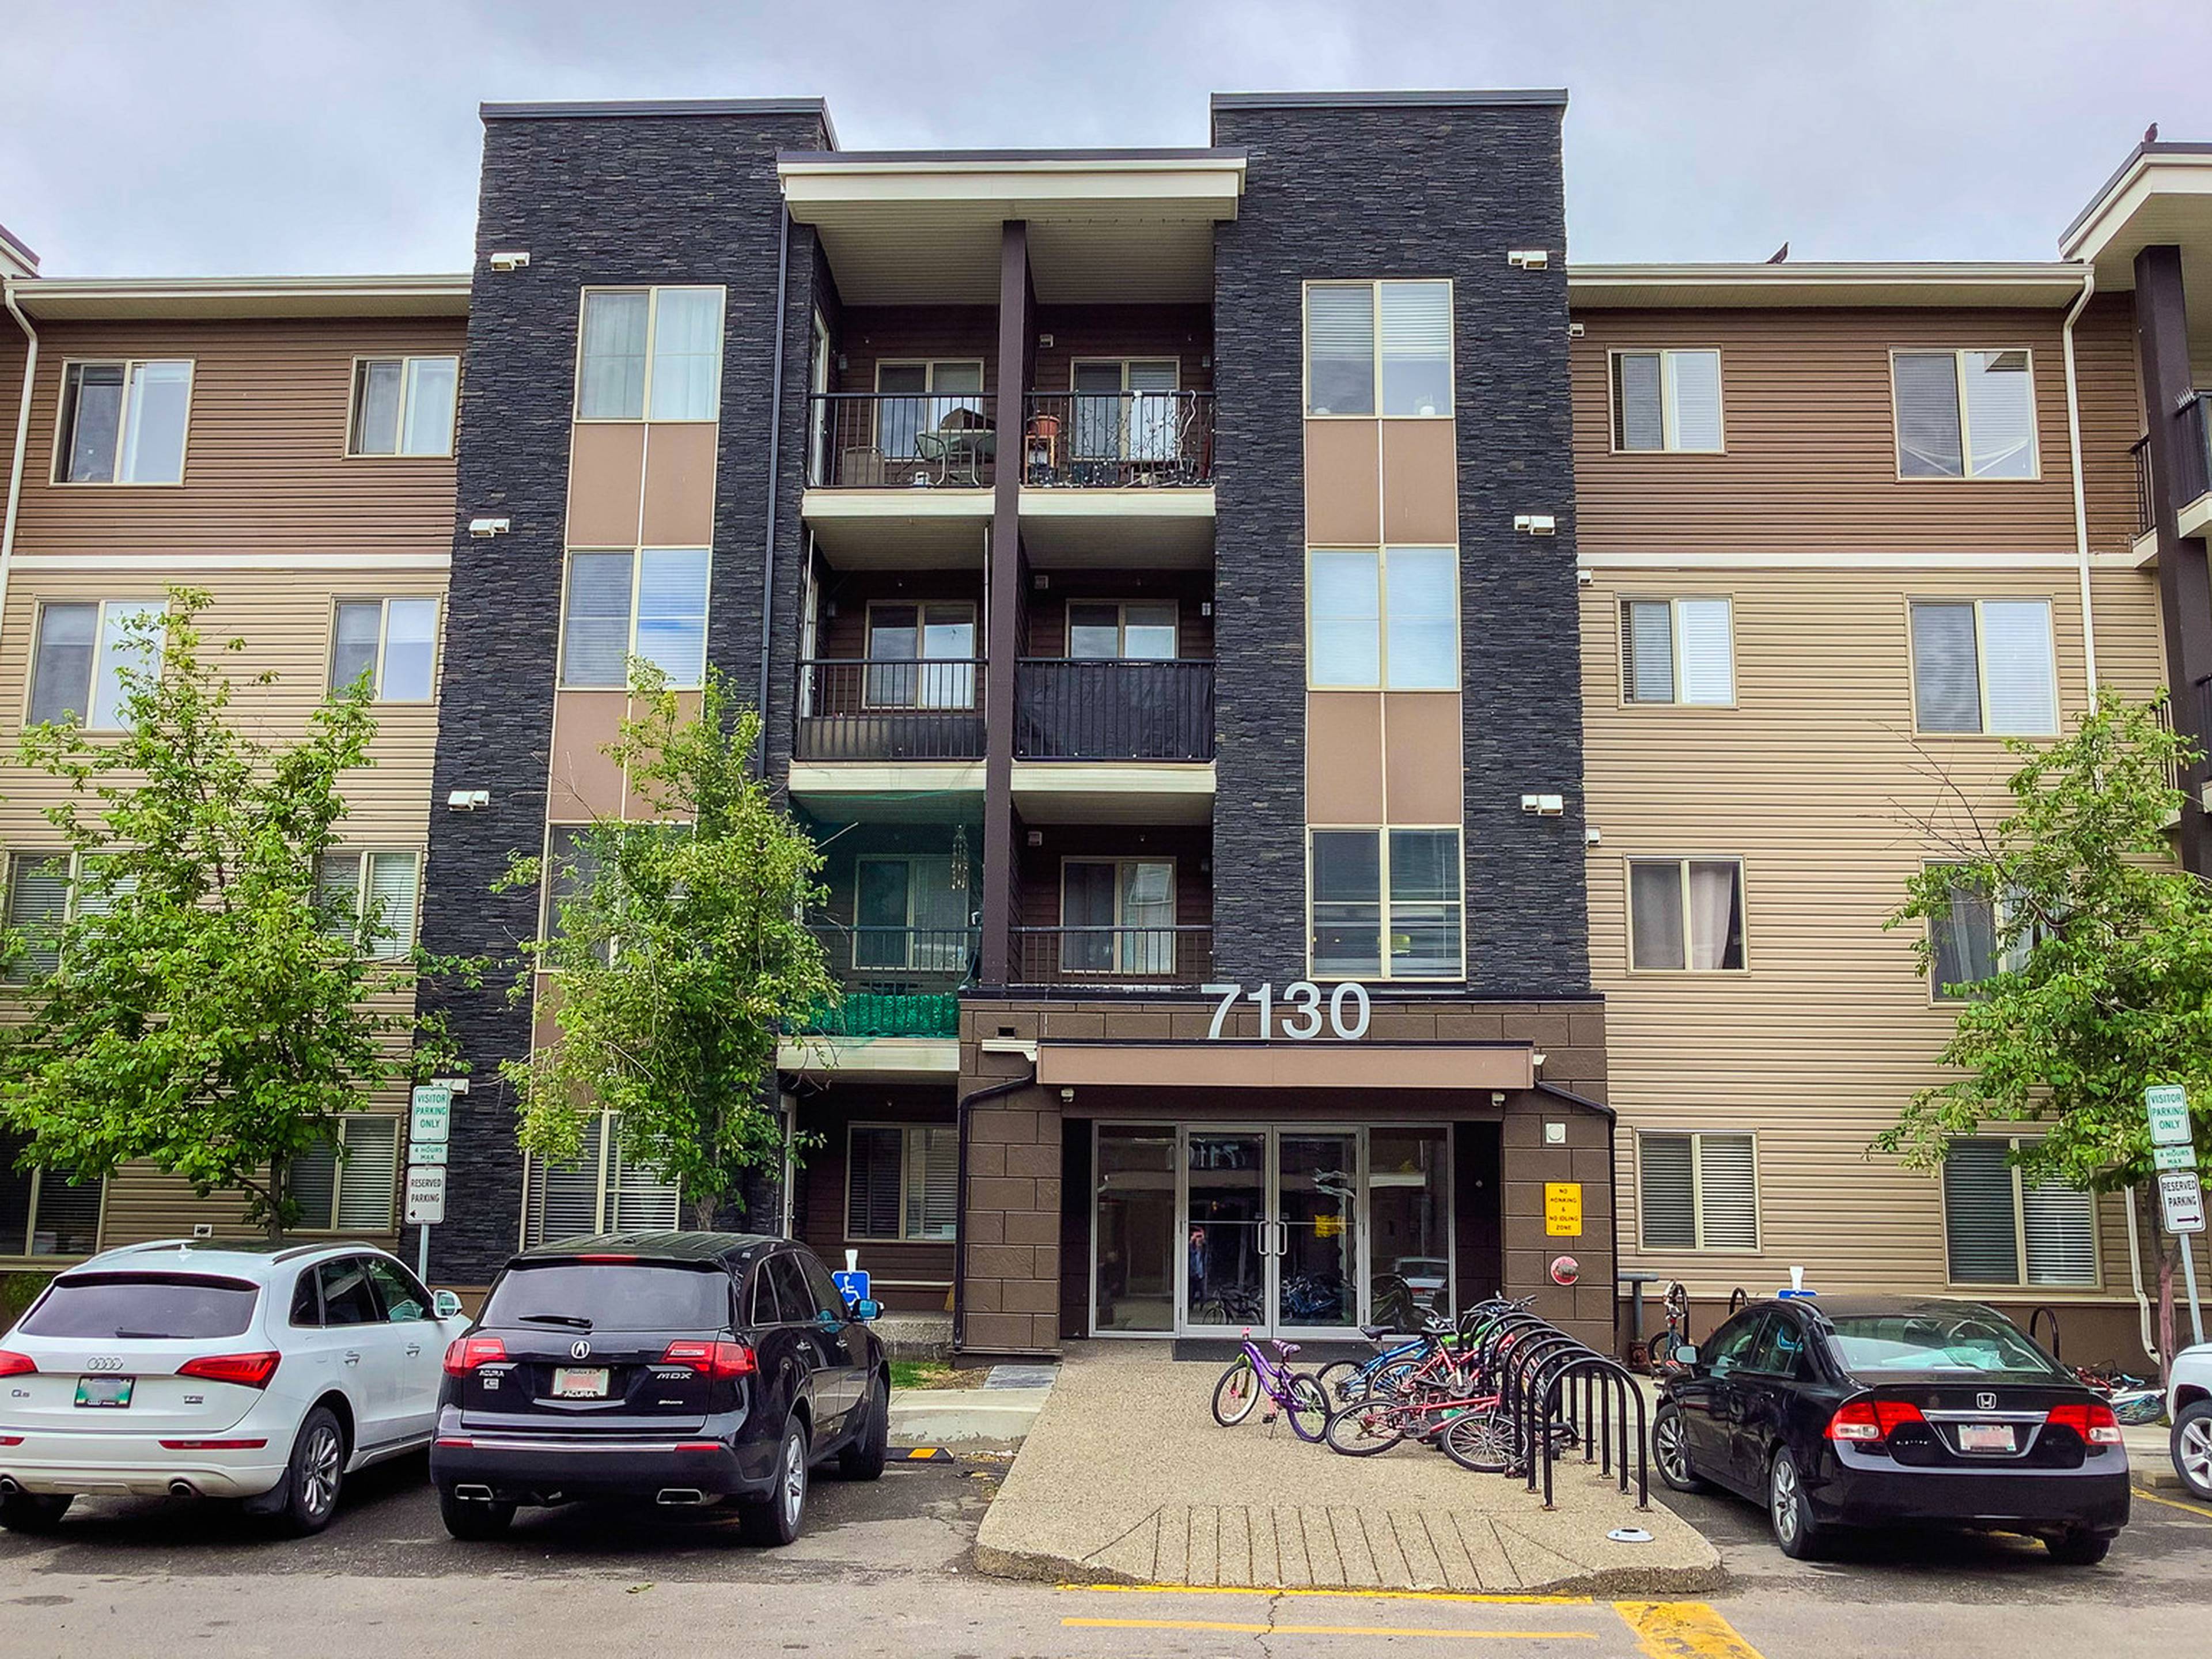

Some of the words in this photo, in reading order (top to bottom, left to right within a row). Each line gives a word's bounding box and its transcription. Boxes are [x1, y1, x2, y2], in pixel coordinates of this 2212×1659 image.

[1200, 981, 1371, 1040] 7130
[416, 1094, 446, 1103] VISITOR
[2150, 1093, 2182, 1104] VISITOR
[415, 1107, 446, 1115] PARKING
[2152, 1106, 2184, 1116] PARKING
[420, 1119, 440, 1128] ONLY
[2159, 1119, 2181, 1130] ONLY
[2165, 1150, 2190, 1158] HOURS
[411, 1178, 441, 1188] RESERVED
[2162, 1180, 2196, 1192] RESERVED
[411, 1193, 440, 1203] PARKING
[2168, 1196, 2197, 1207] PARKING
[479, 1369, 505, 1377] ACURA
